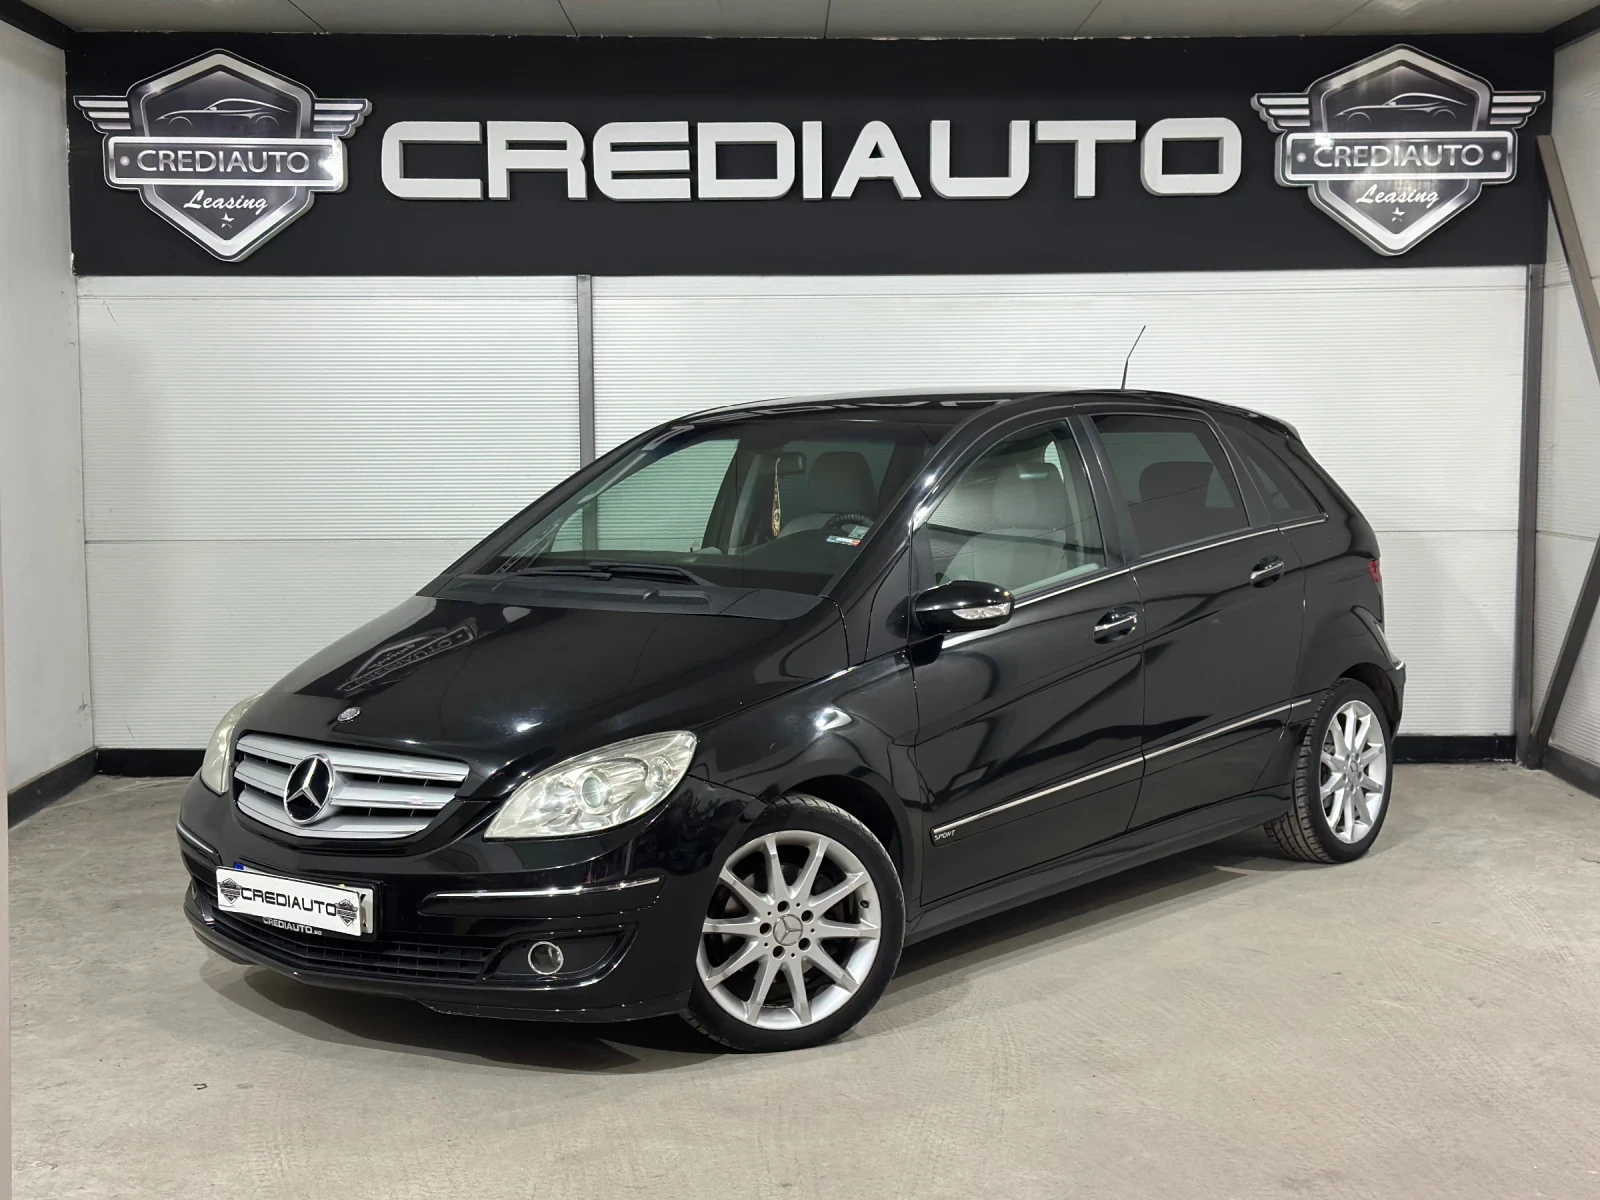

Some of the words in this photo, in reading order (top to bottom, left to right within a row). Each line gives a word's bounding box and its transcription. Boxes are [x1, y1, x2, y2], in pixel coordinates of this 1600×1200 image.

[136, 149, 310, 173] CREDIAUTO
[381, 117, 1241, 198] CREDIAUTO
[1313, 144, 1485, 168] CREDIAUTO
[183, 189, 268, 215] Leasing
[1356, 184, 1440, 208] Leasing
[934, 829, 956, 842] SPORT
[241, 887, 337, 916] CREDIAUTO
